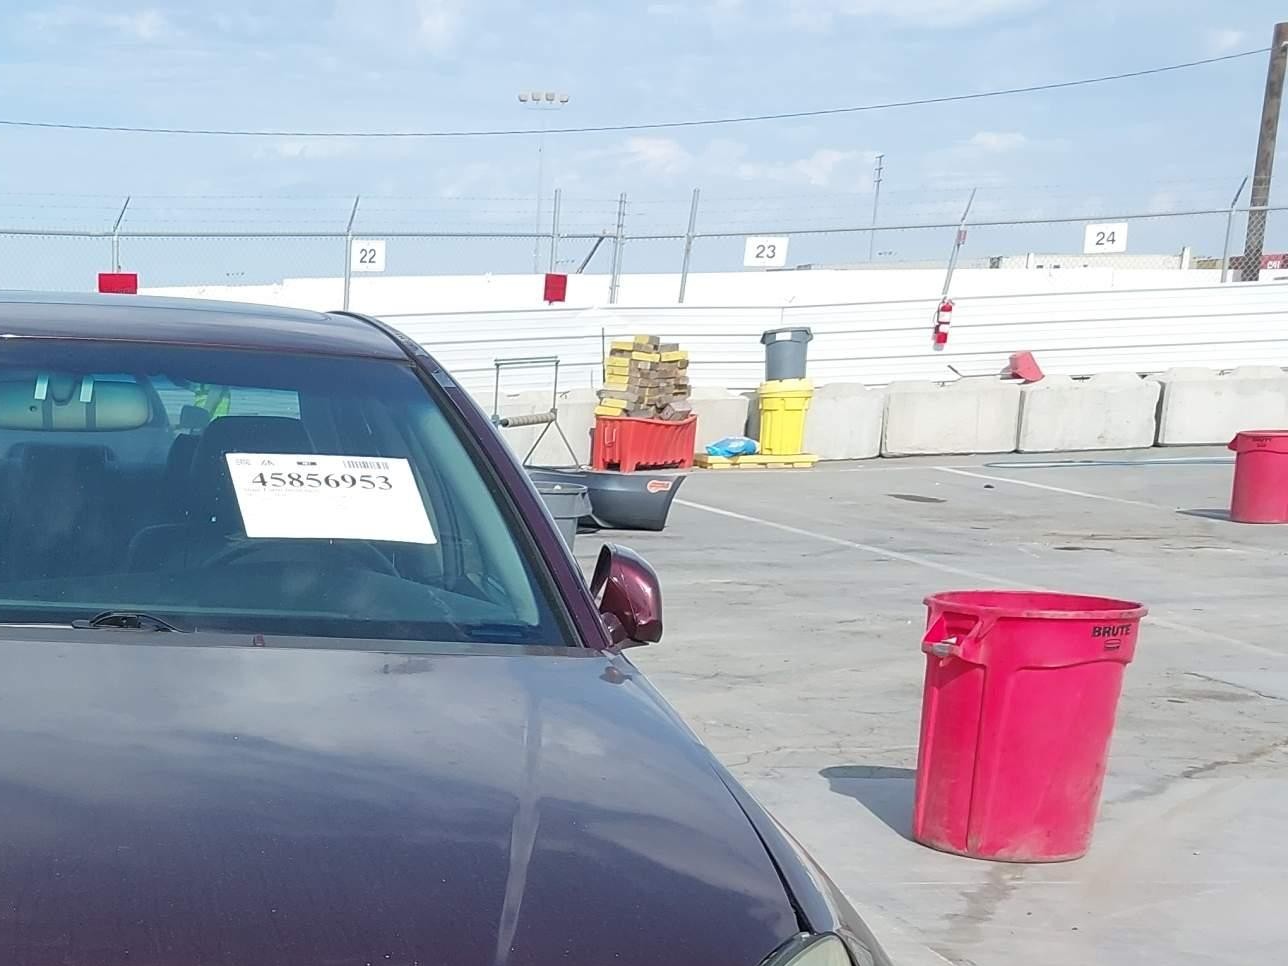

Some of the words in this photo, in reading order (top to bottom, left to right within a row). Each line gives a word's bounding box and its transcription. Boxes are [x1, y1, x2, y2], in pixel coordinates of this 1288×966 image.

[1095, 231, 1117, 246] 24
[359, 248, 377, 264] 22
[755, 244, 777, 259] 23
[252, 472, 393, 491] 45856953
[1092, 624, 1132, 637] BRUTE
